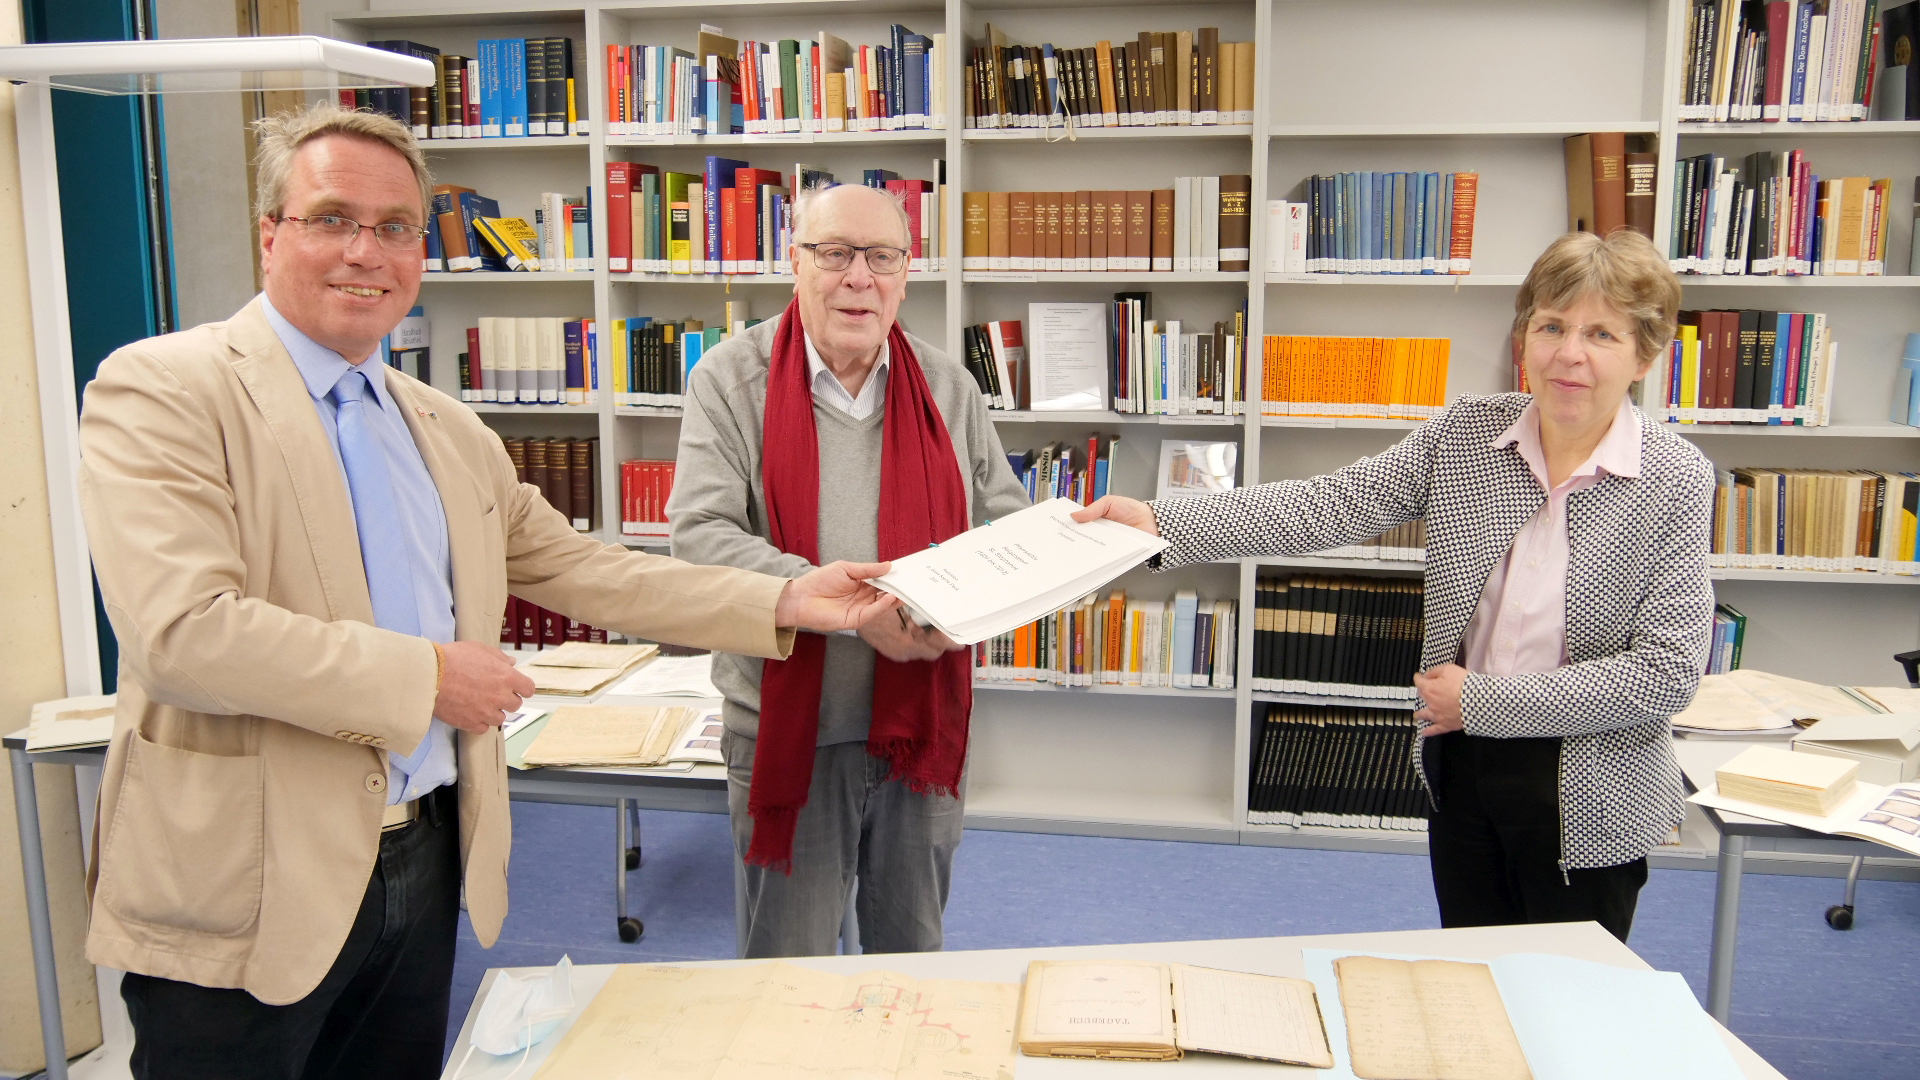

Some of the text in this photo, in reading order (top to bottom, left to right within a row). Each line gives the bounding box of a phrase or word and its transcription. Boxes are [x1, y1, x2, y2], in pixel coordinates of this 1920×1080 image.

[1801, 9, 1810, 33] Aachen
[1802, 35, 1808, 43] zu
[1798, 45, 1806, 60] Dom
[1797, 62, 1805, 73] Der
[708, 224, 716, 252] Heiligen
[1041, 451, 1050, 482] MISSIO
[1876, 482, 1885, 508] WENAU
[525, 618, 530, 627] 8
[546, 618, 551, 628] 9
[570, 619, 578, 628] 10
[1068, 1016, 1130, 1026] TAGEBUCH
